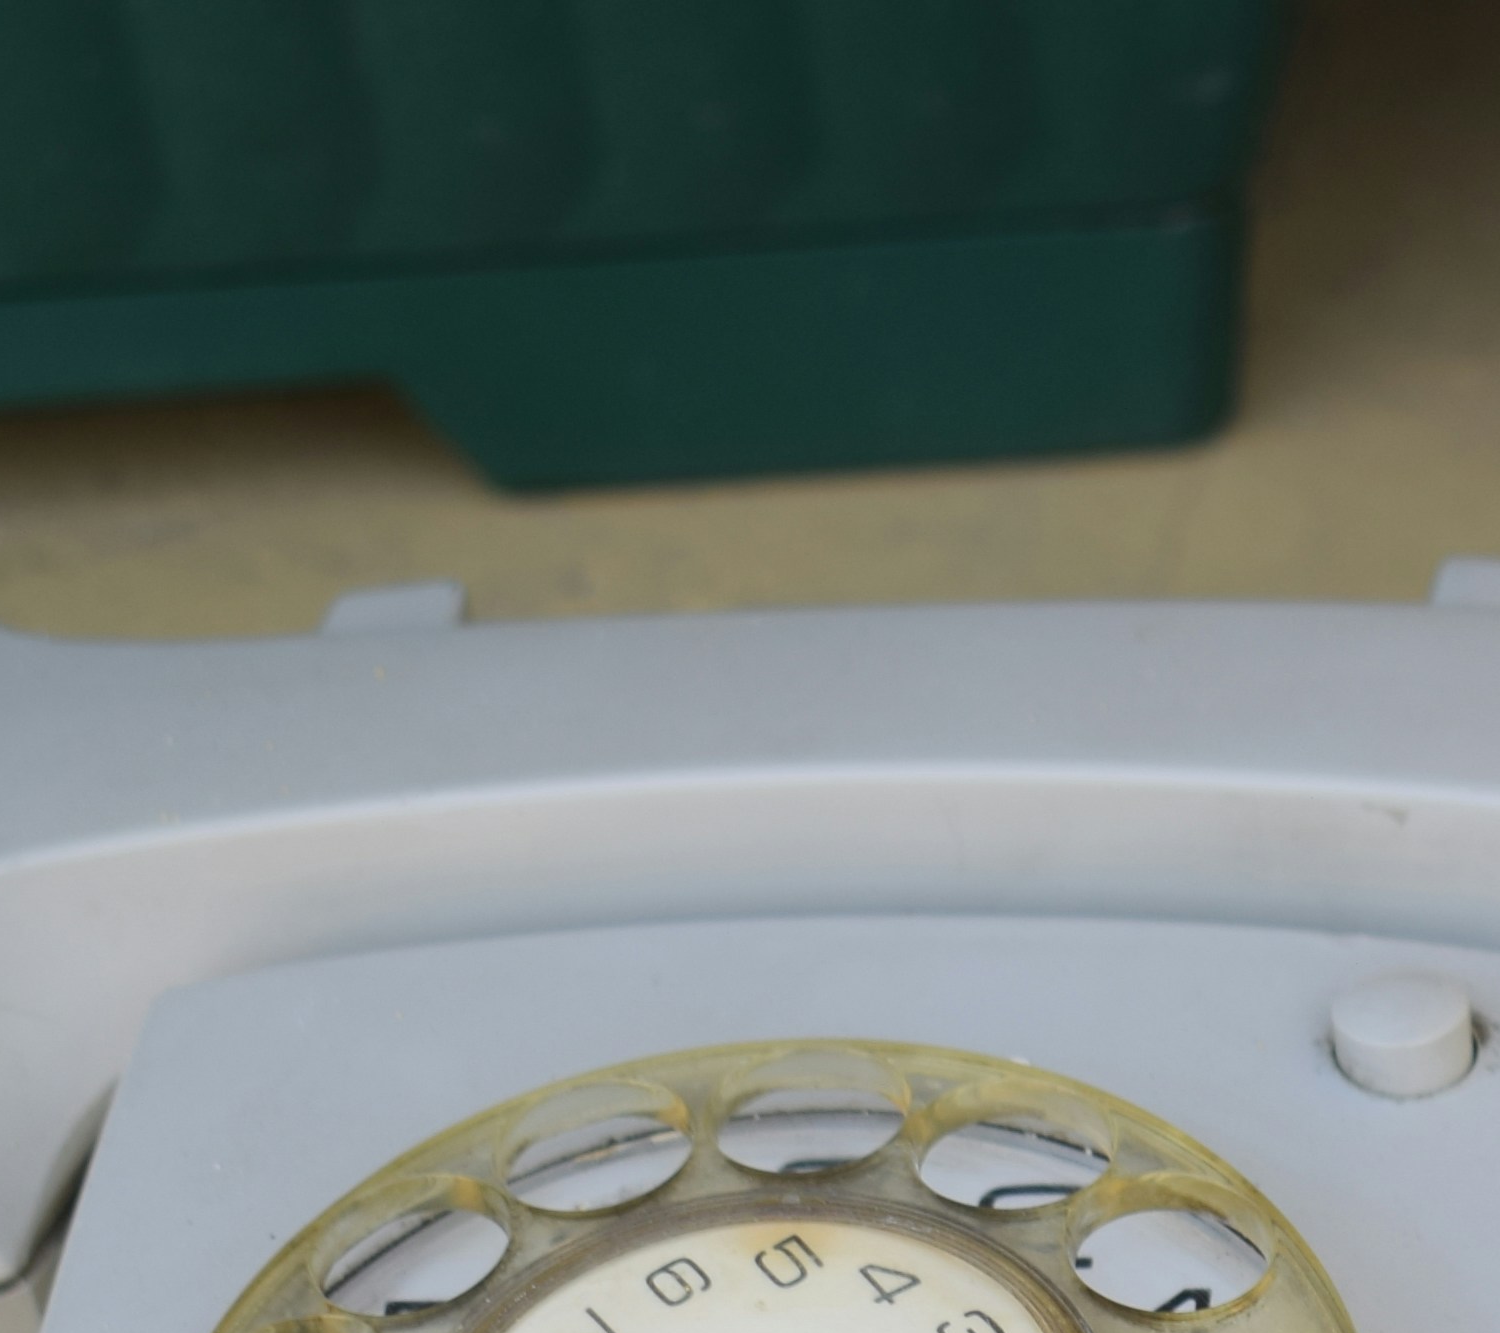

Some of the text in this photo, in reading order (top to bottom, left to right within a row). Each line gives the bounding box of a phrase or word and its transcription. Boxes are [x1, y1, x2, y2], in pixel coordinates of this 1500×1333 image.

[645, 1257, 712, 1307] 6
[754, 1234, 824, 1288] 5
[859, 1264, 921, 1305] 4
